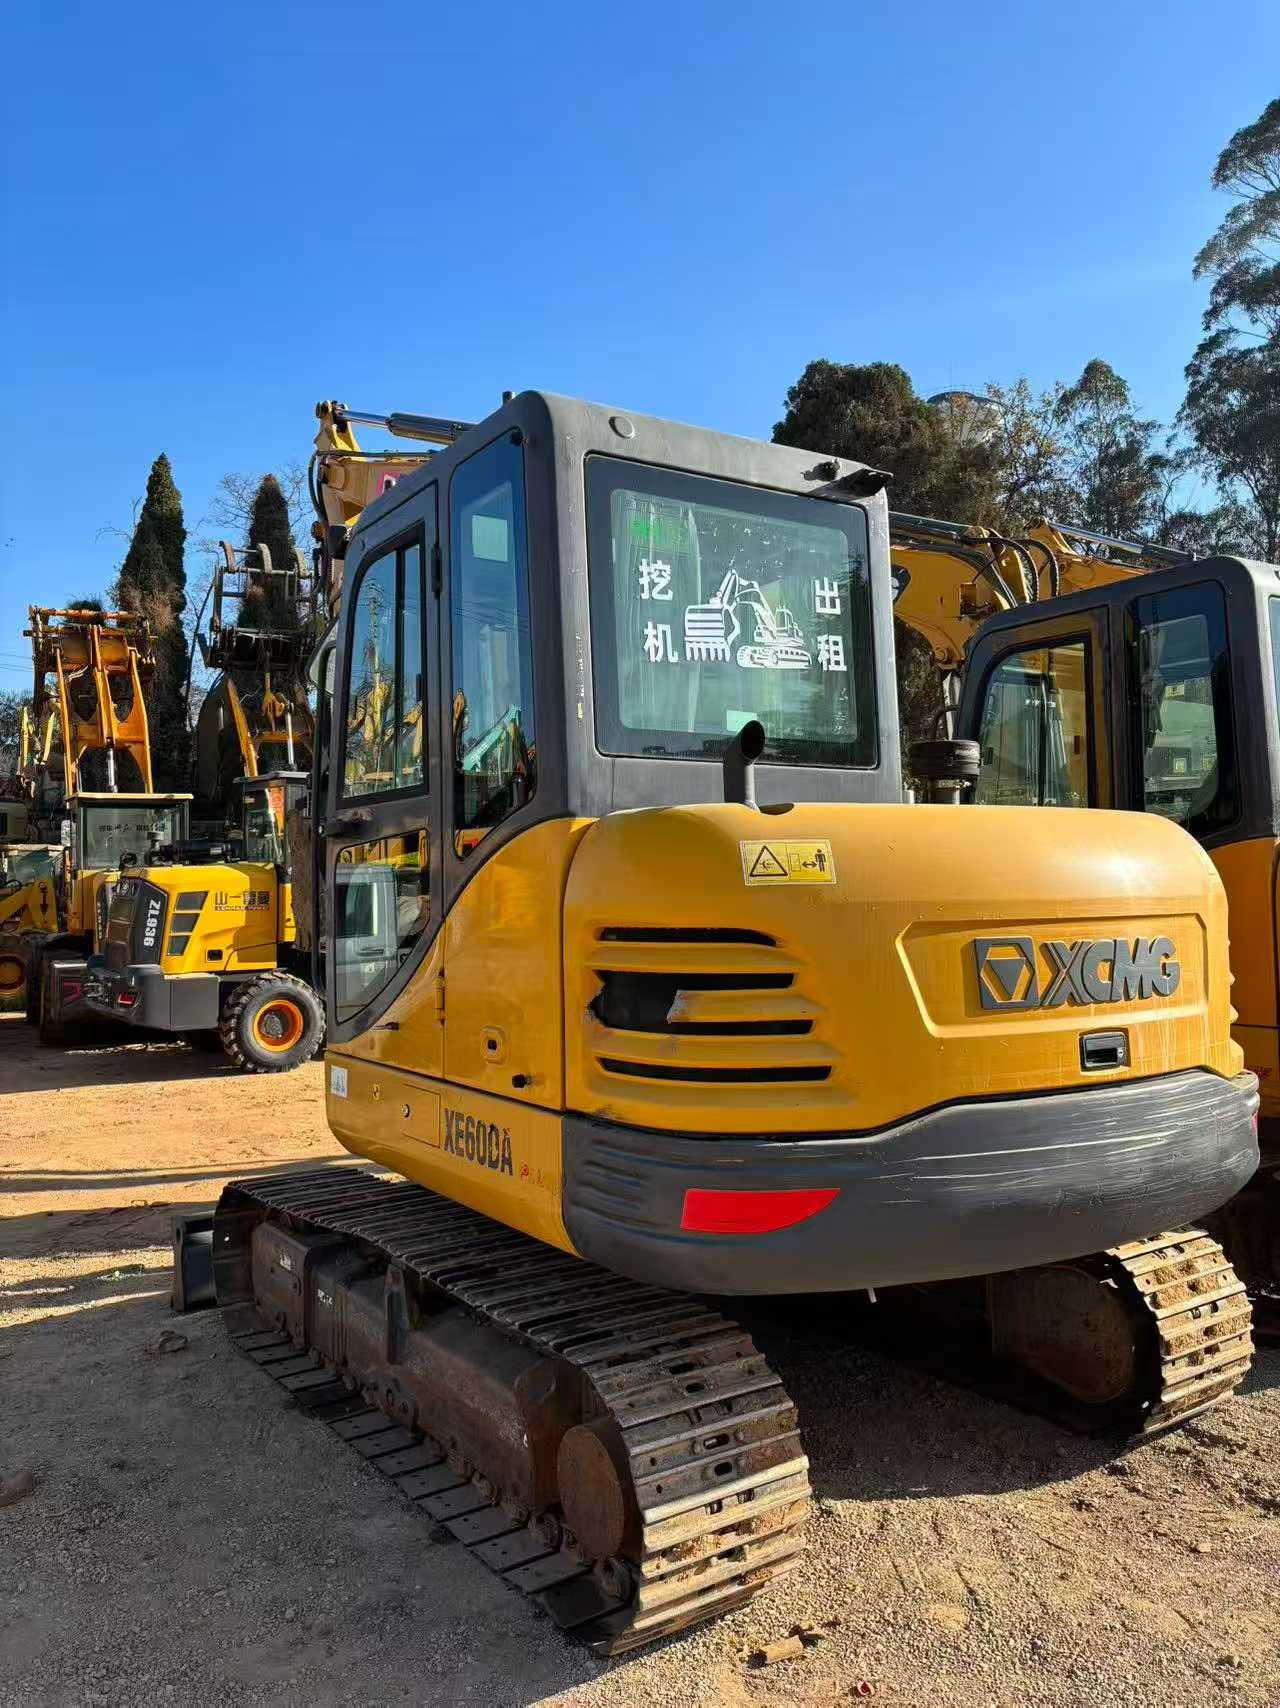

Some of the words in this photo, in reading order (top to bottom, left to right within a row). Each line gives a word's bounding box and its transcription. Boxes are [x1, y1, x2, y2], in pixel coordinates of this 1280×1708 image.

[639, 558, 679, 663] 挖机
[814, 576, 848, 672] 出租
[1040, 936, 1180, 1008] XCMG
[444, 1107, 514, 1176] XE60DA
